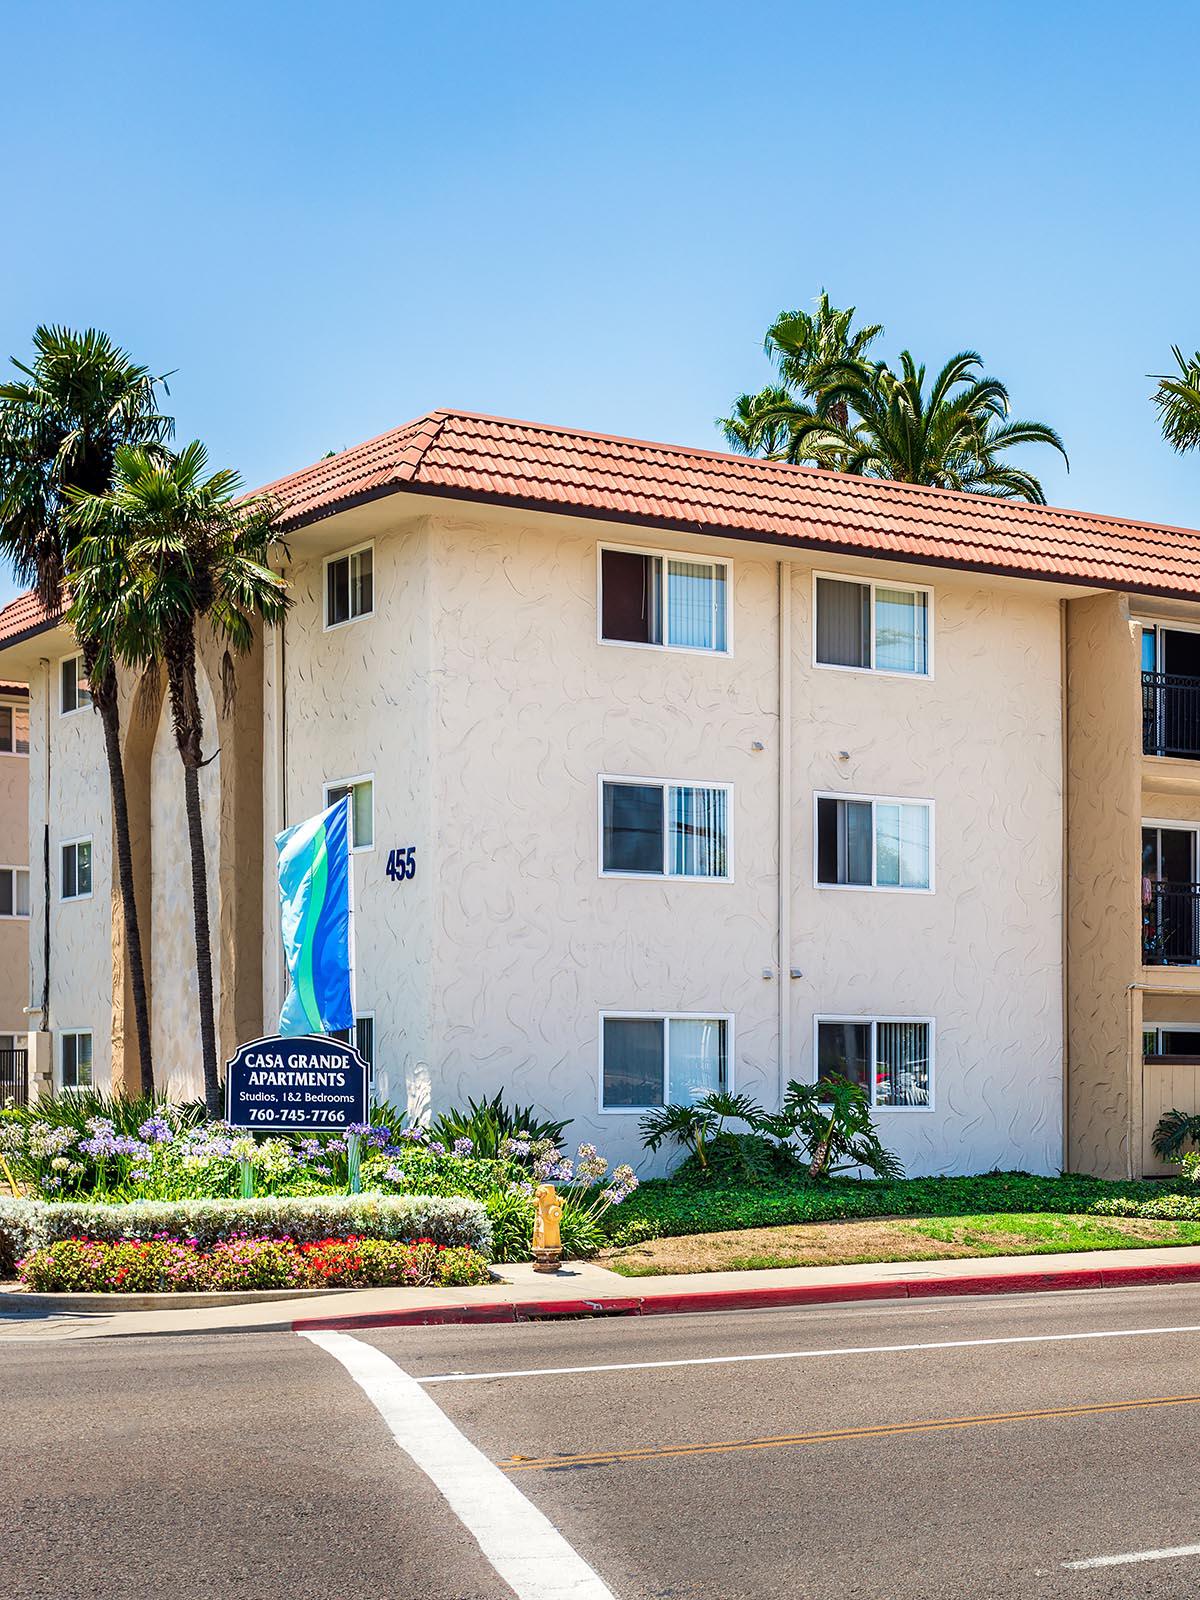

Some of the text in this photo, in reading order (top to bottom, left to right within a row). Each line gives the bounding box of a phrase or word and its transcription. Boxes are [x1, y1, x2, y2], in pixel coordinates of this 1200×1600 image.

[386, 846, 416, 881] 455
[244, 1054, 350, 1069] CASA GRANDE
[248, 1072, 346, 1087] APARTMENTS
[239, 1091, 355, 1103] Studios, 1&2 Bedrooms
[249, 1108, 346, 1122] 760-745-7766
